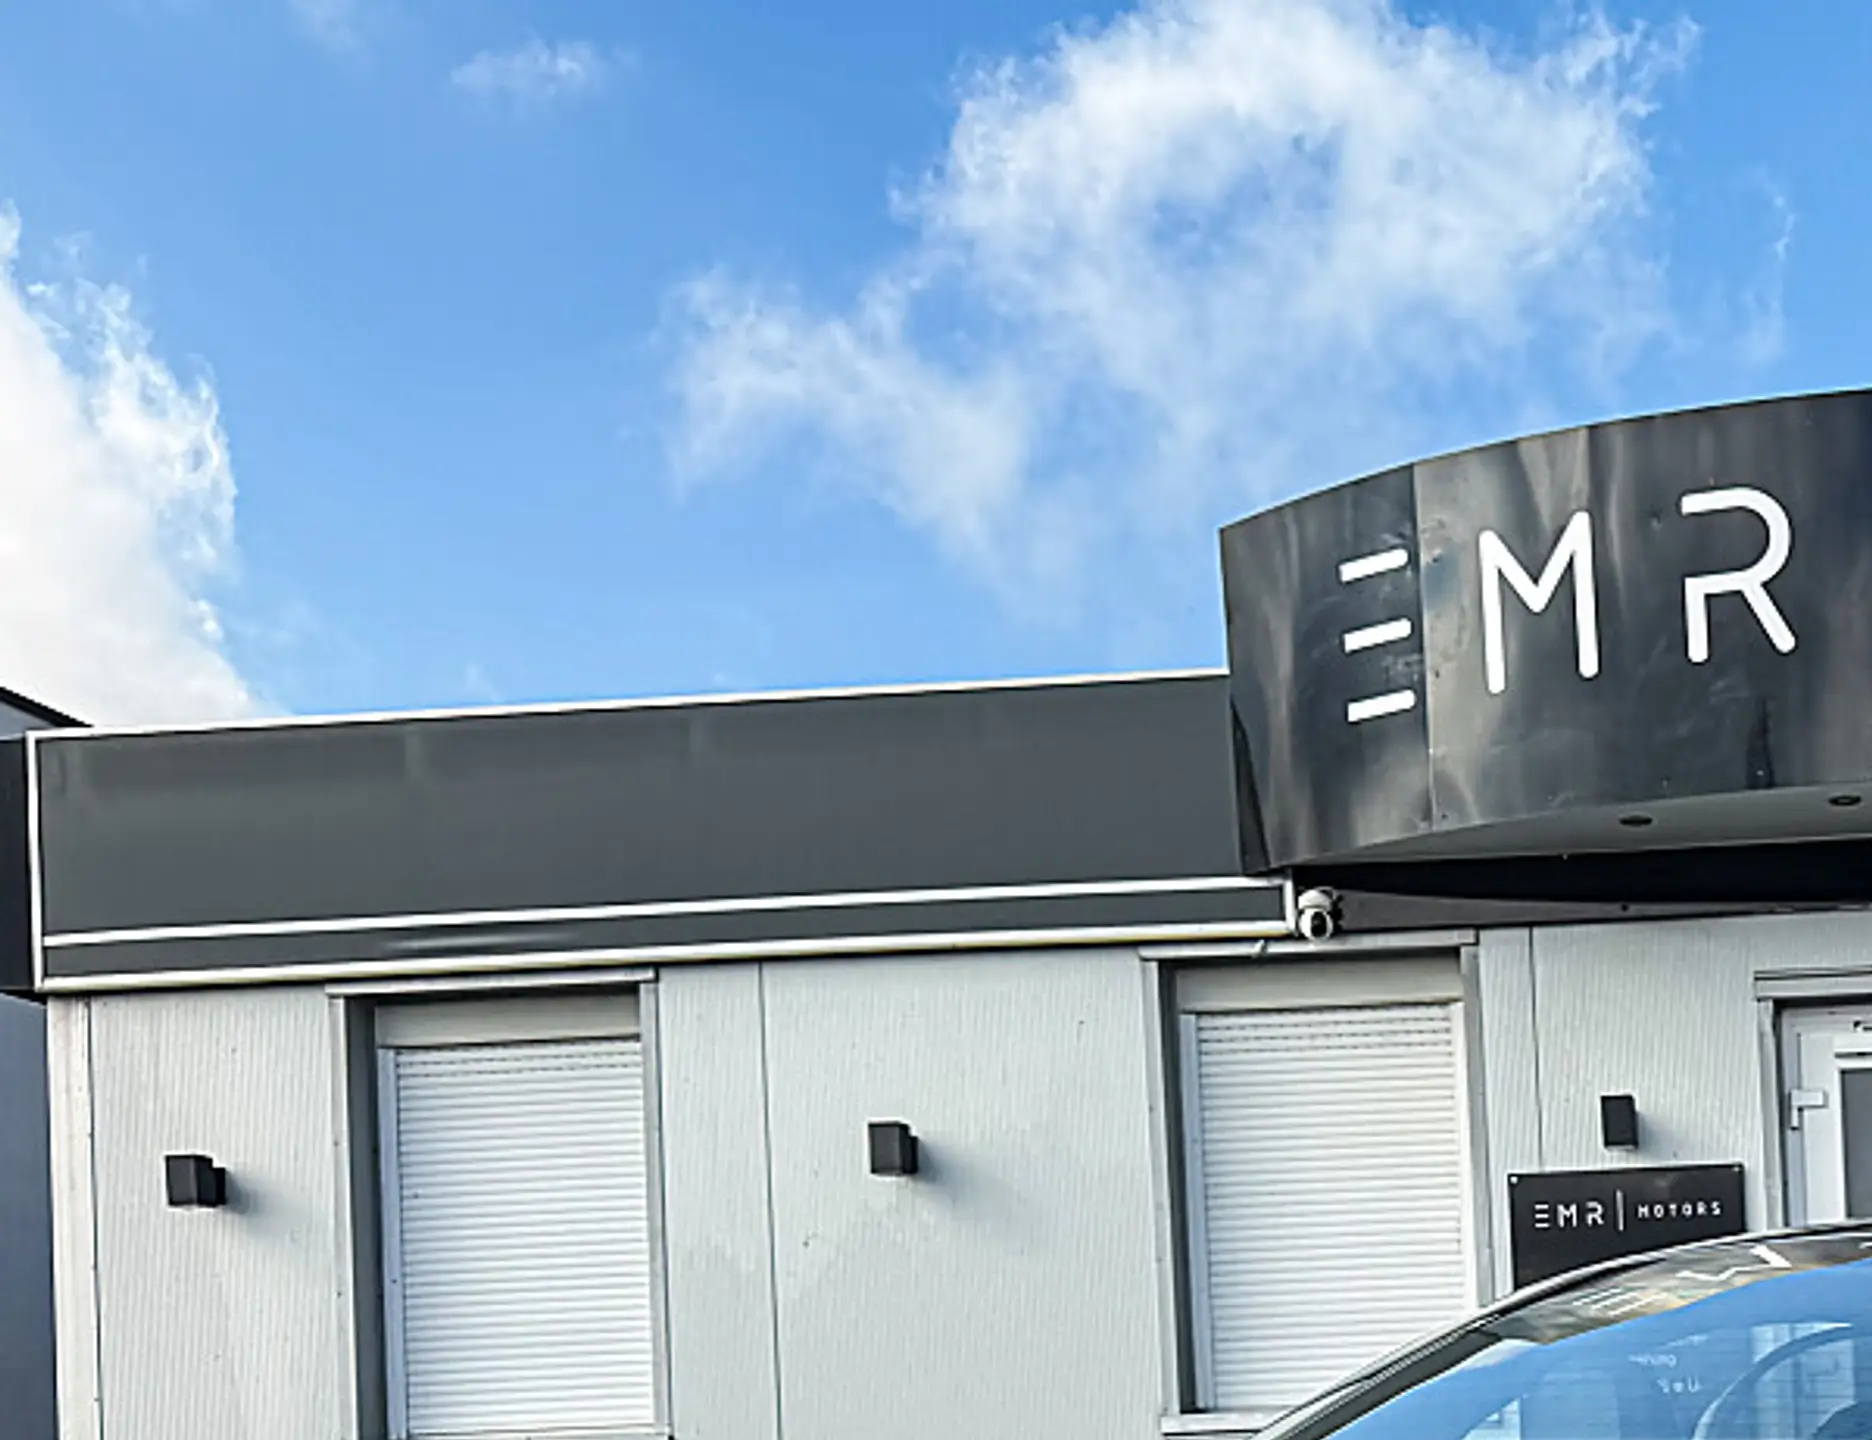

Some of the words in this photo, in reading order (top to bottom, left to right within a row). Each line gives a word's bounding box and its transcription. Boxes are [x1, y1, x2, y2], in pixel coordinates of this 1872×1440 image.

[1338, 487, 1796, 724] EMR
[1534, 1201, 1605, 1228] EMR
[1637, 1201, 1722, 1219] MOTORS
